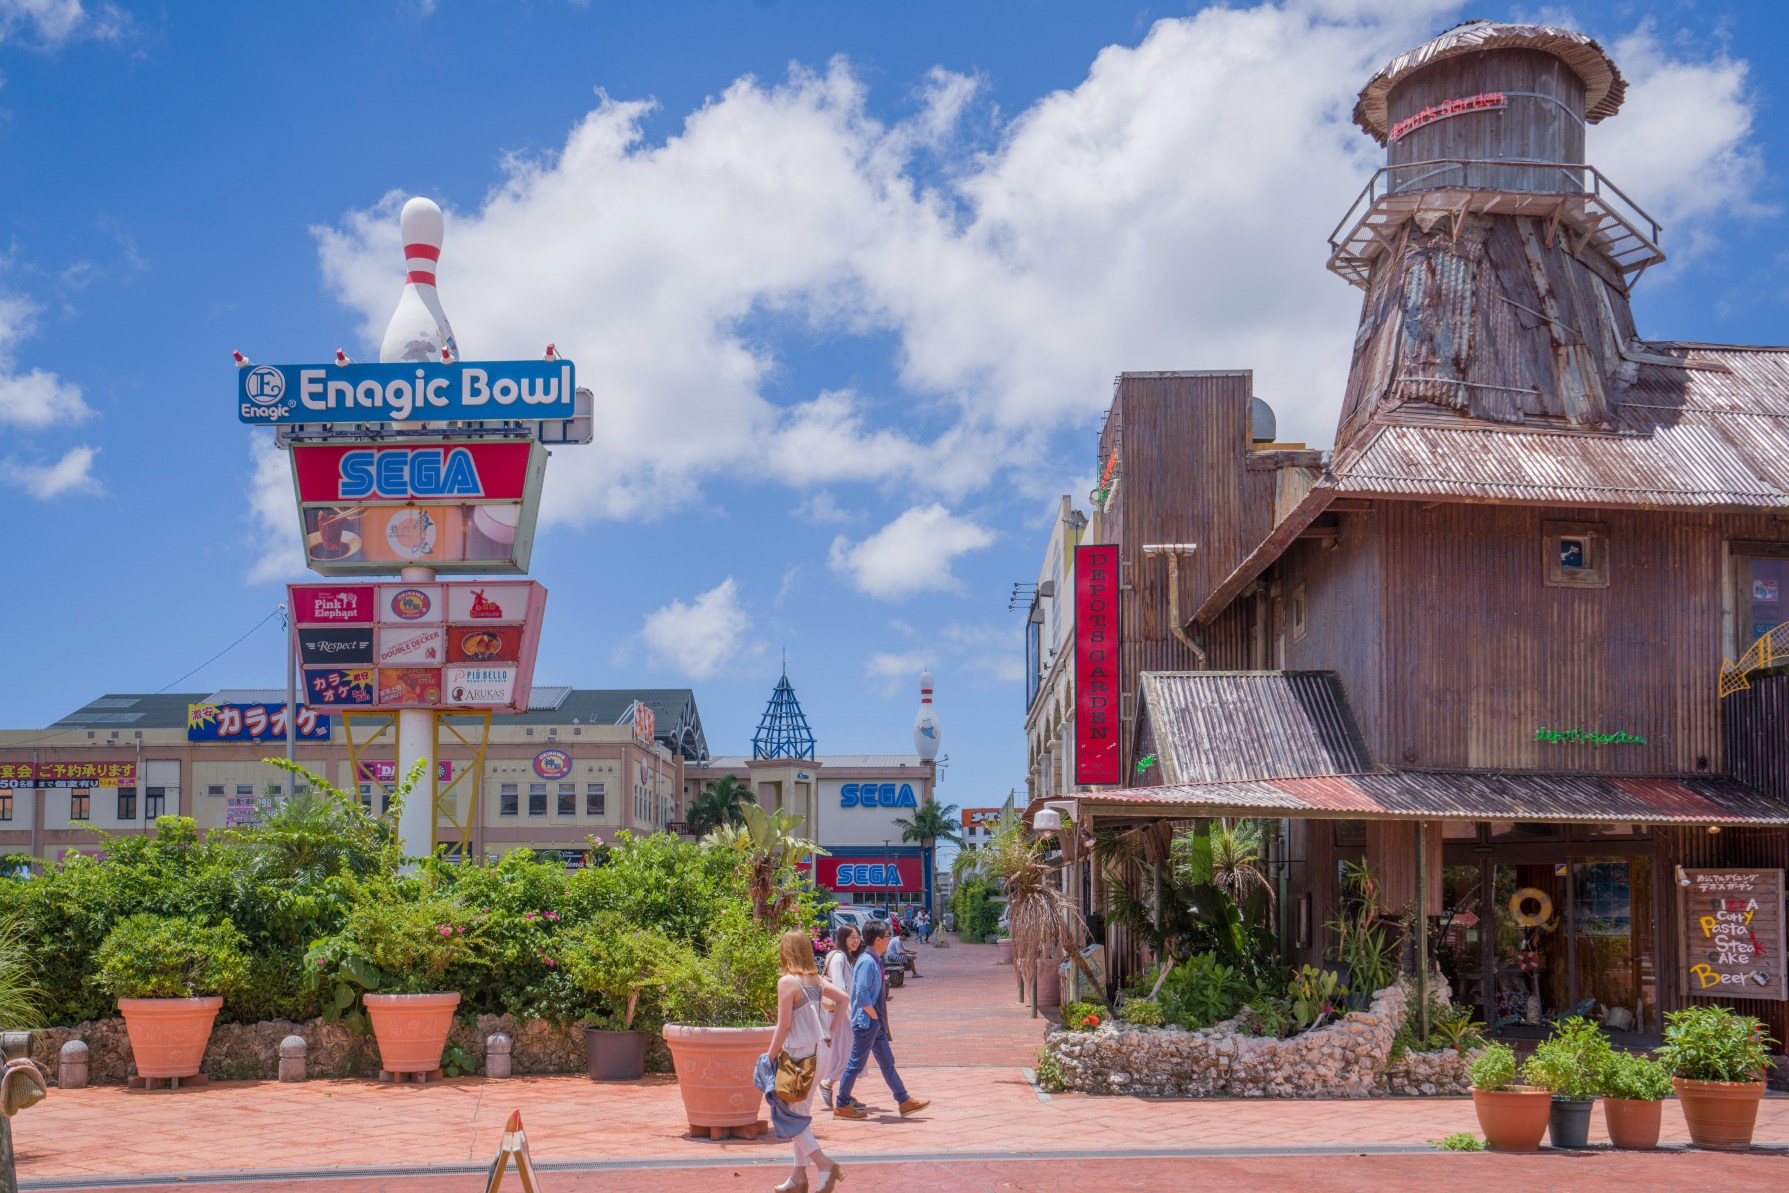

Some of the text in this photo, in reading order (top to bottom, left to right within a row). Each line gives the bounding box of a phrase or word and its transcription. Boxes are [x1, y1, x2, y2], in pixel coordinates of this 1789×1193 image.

[1441, 91, 1505, 116] Garden
[300, 365, 571, 420] Enagic Bowl
[241, 403, 290, 421] Enagic
[338, 447, 485, 499] SEGA
[315, 599, 341, 609] Pink
[397, 591, 425, 600] OKINAWA
[315, 609, 358, 620] Elephant
[316, 640, 358, 653] Respect
[381, 632, 439, 660] DOUBLE DECKER
[483, 671, 507, 680] BELLO
[465, 689, 505, 700] ARUKAS
[1088, 649, 1108, 739] GARDEN
[540, 752, 566, 760] OKINAWA
[0, 763, 135, 778] 宴会 ご予約承ります
[840, 783, 918, 808] SEGA
[836, 863, 904, 887] SEGA
[1711, 898, 1759, 911] PIZZA
[1716, 910, 1754, 925] Curry
[1700, 916, 1748, 938] Pasta
[1715, 931, 1767, 957] Steak
[1690, 963, 1750, 989] Beer
